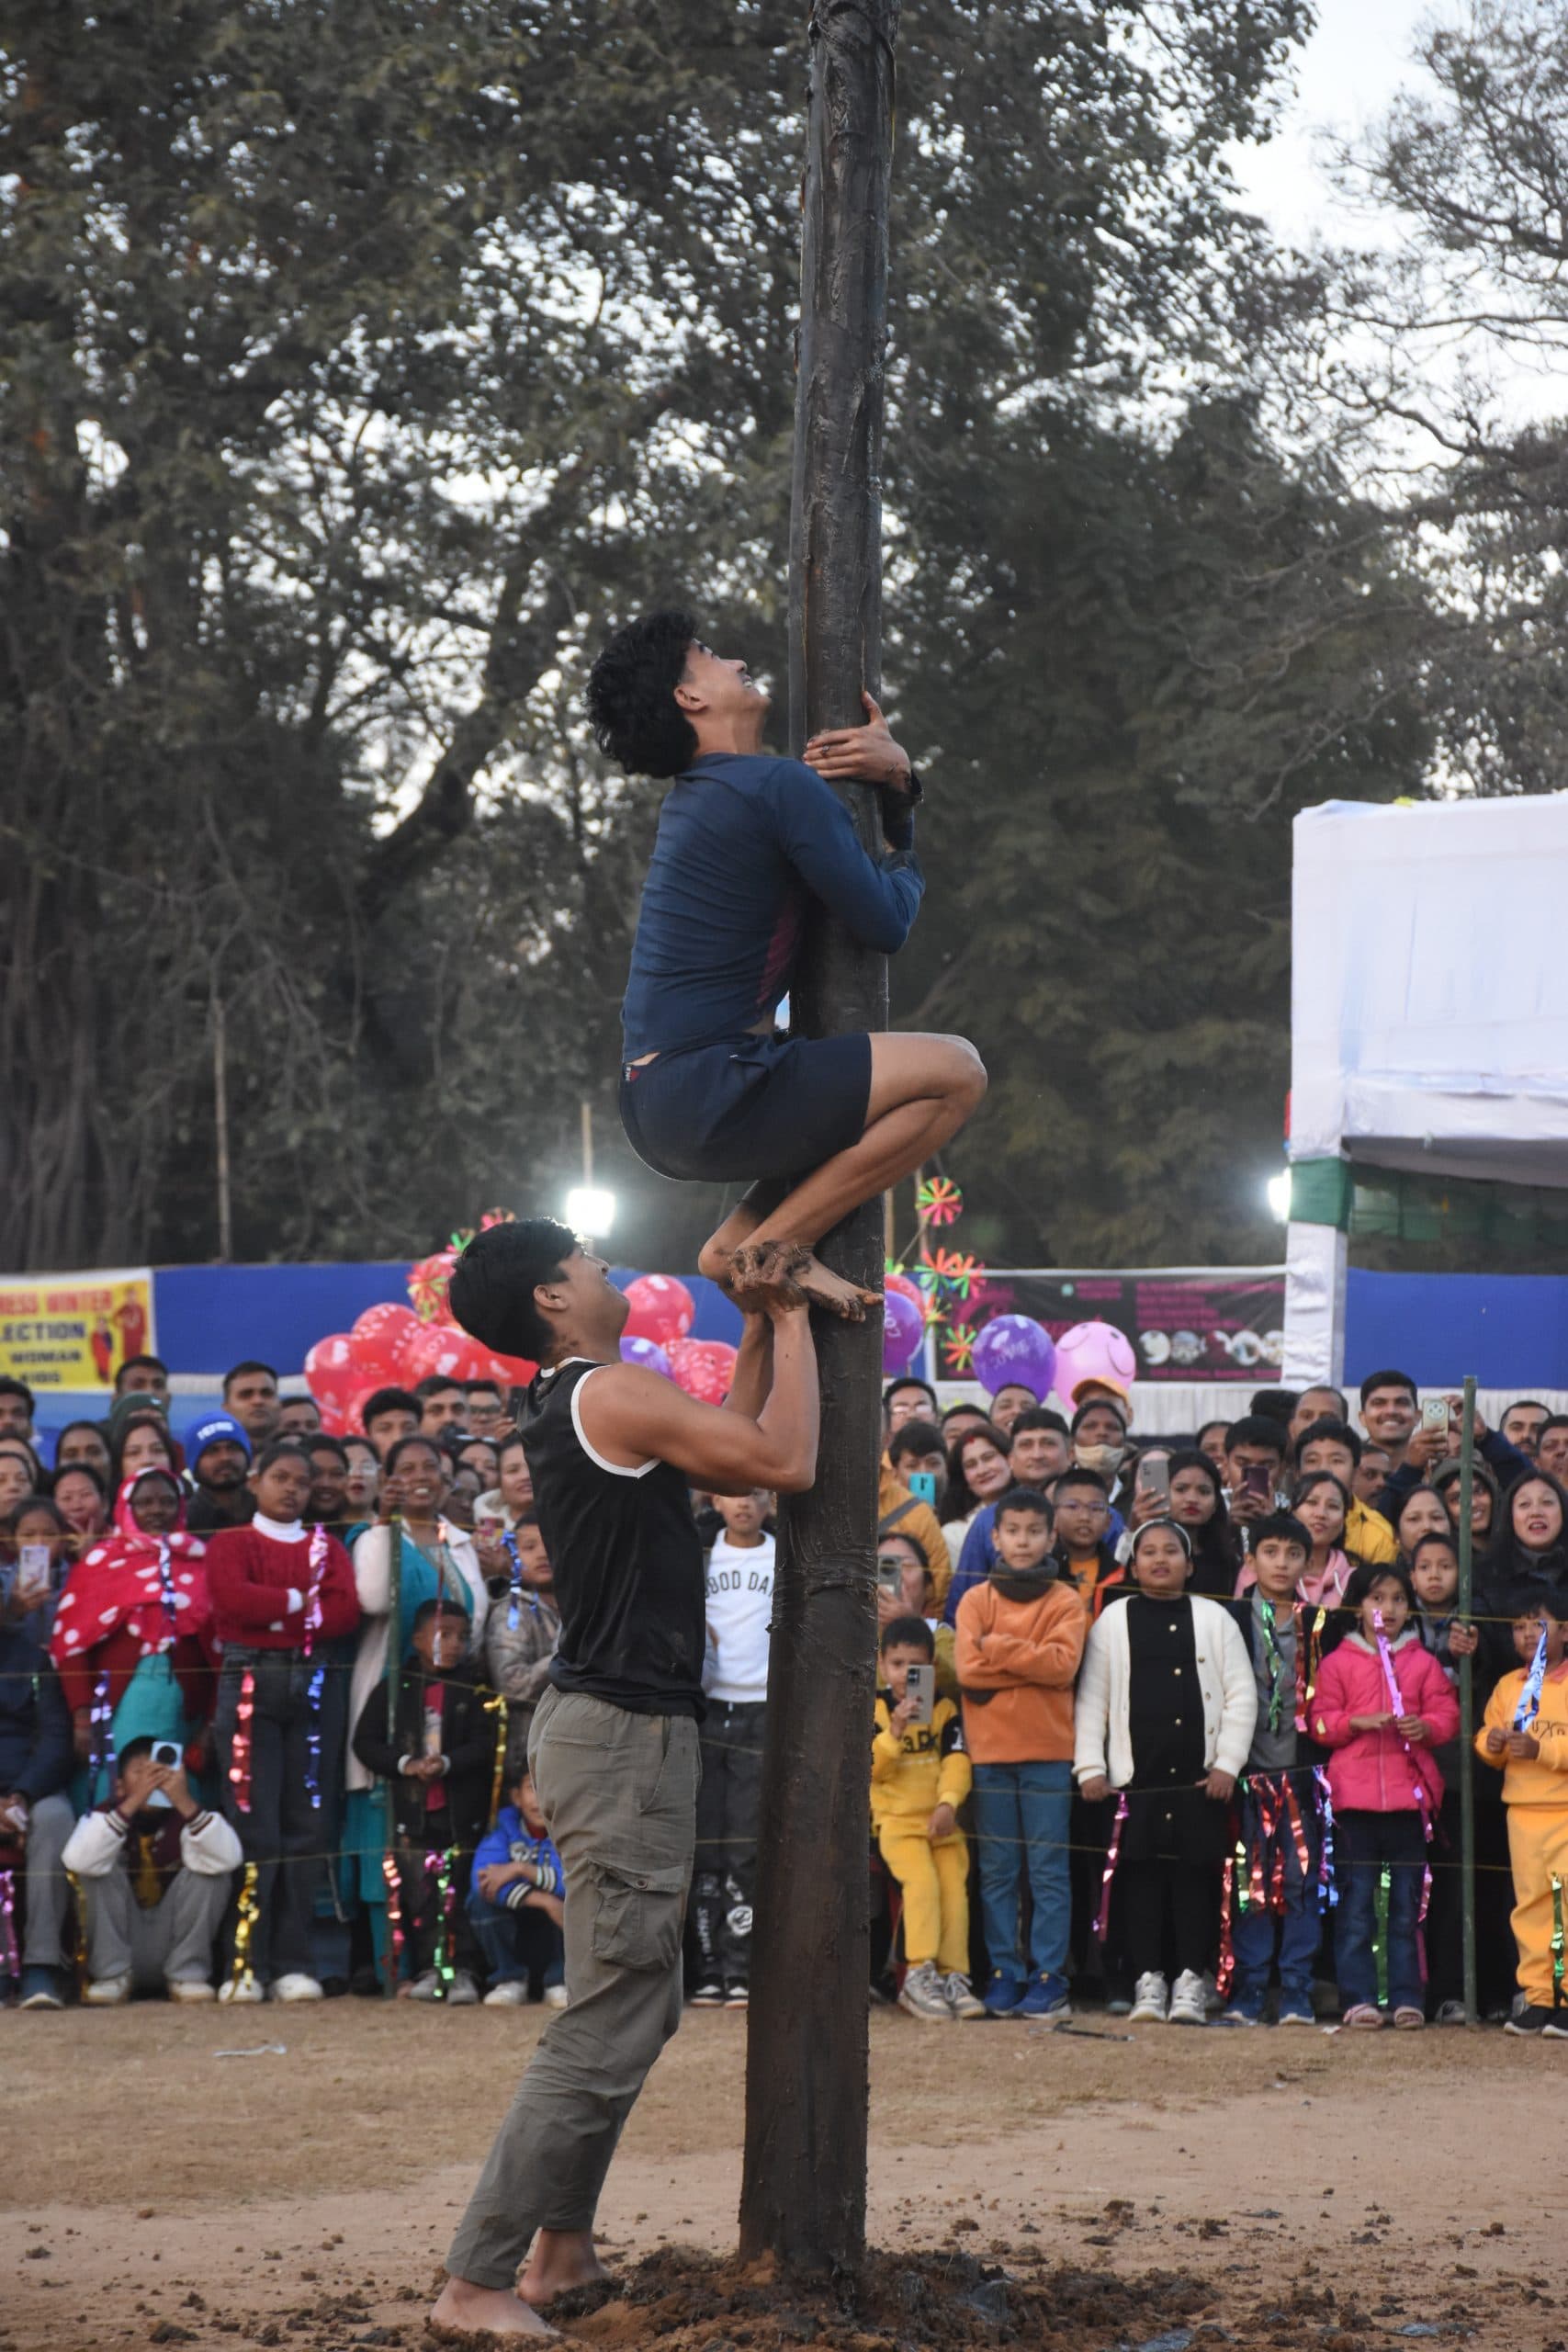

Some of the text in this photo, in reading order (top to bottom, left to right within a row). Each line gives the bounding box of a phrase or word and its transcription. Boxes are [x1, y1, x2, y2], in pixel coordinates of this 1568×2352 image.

[10, 1350, 82, 1363] WOMAN
[705, 1569, 773, 1599] OOD DA
